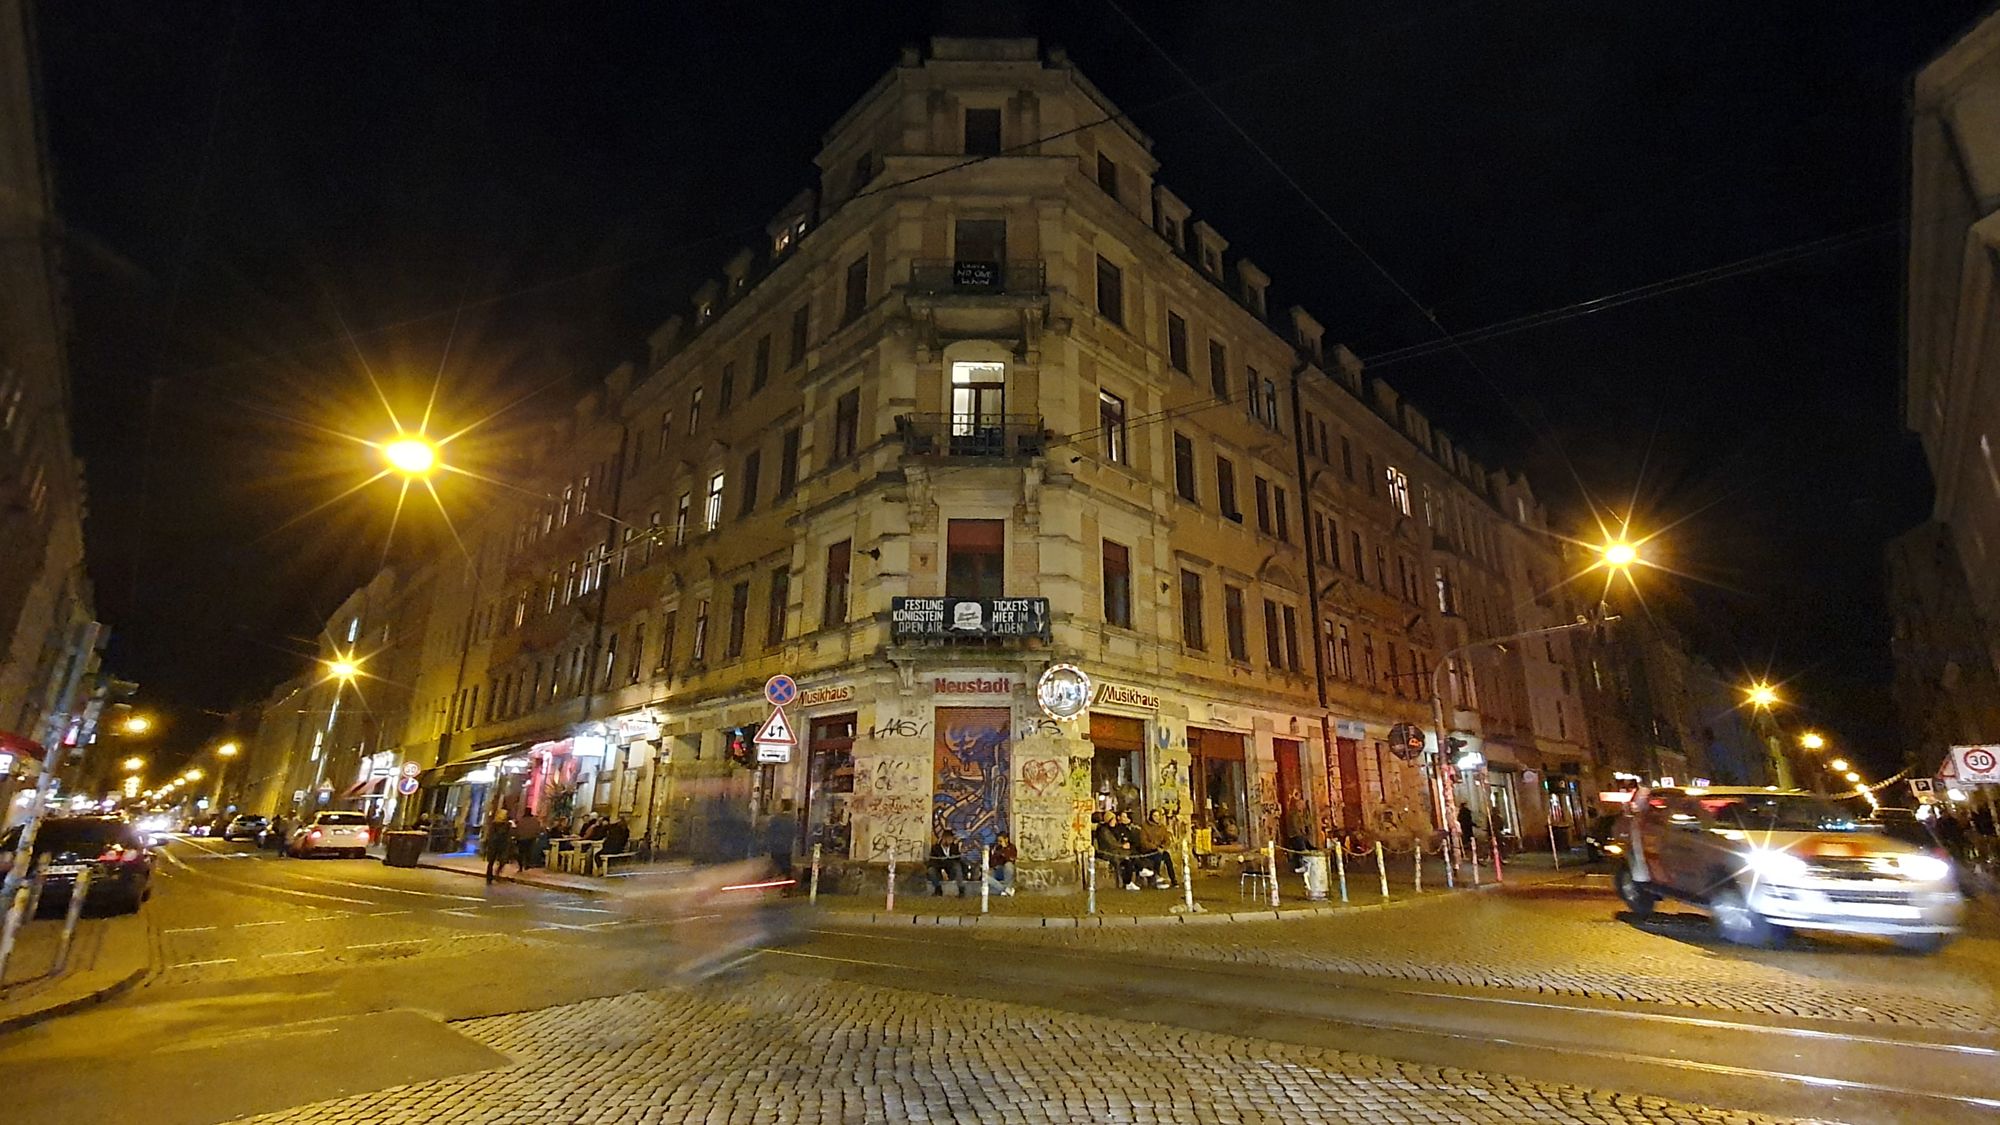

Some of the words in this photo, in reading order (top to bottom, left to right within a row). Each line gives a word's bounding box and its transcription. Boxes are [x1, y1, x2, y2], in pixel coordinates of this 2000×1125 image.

[904, 600, 944, 611] FESTUNG
[993, 600, 1029, 611] TICKETS
[893, 610, 944, 622] KÖNIGSTEIN
[992, 612, 1014, 622] HIER
[1017, 612, 1029, 622] IM
[898, 622, 924, 633] OPEN
[927, 622, 943, 633] AIR
[992, 622, 1023, 634] LADEN
[934, 678, 1010, 694] Neustadt
[798, 686, 848, 705] Musikhaus
[1100, 685, 1159, 707] Musikhaus
[1969, 755, 1989, 766] 30
